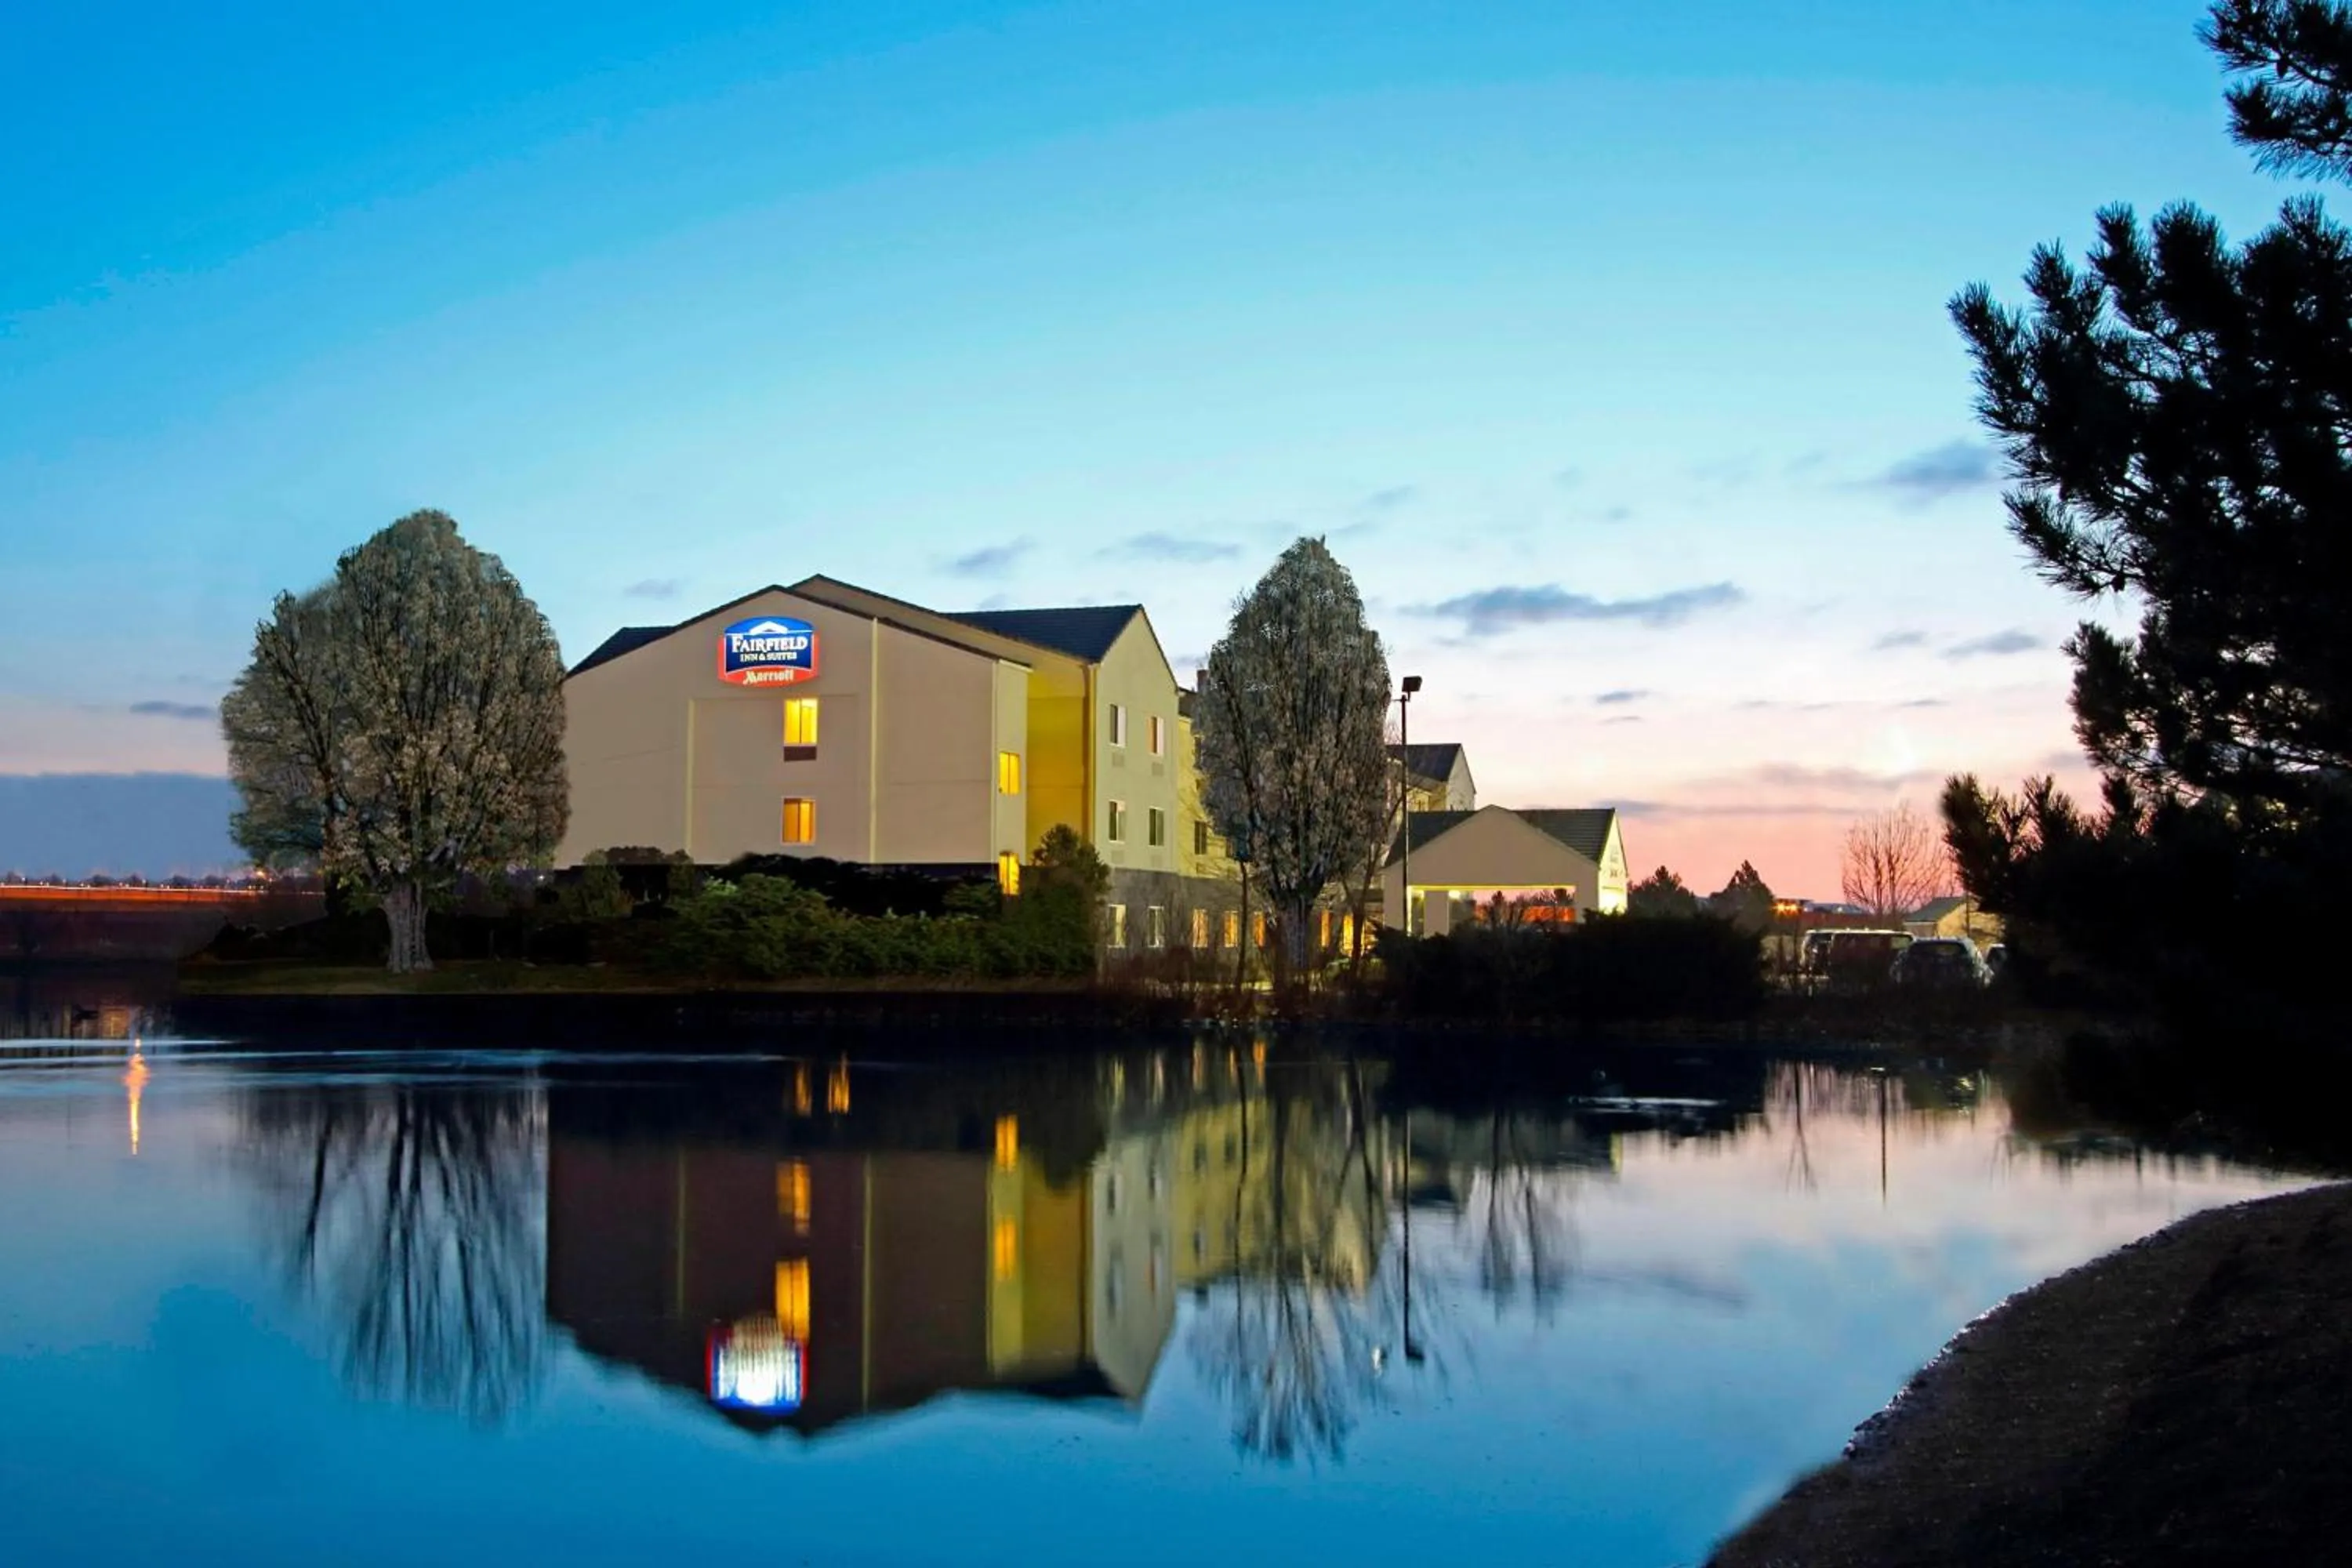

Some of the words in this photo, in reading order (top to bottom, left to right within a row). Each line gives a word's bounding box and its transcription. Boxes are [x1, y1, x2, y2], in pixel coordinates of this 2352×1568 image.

[731, 633, 808, 653] FAIRFIELD
[740, 653, 757, 662] INN
[758, 652, 766, 661] &
[767, 652, 797, 661] SUITES
[742, 669, 794, 684] Marriott
